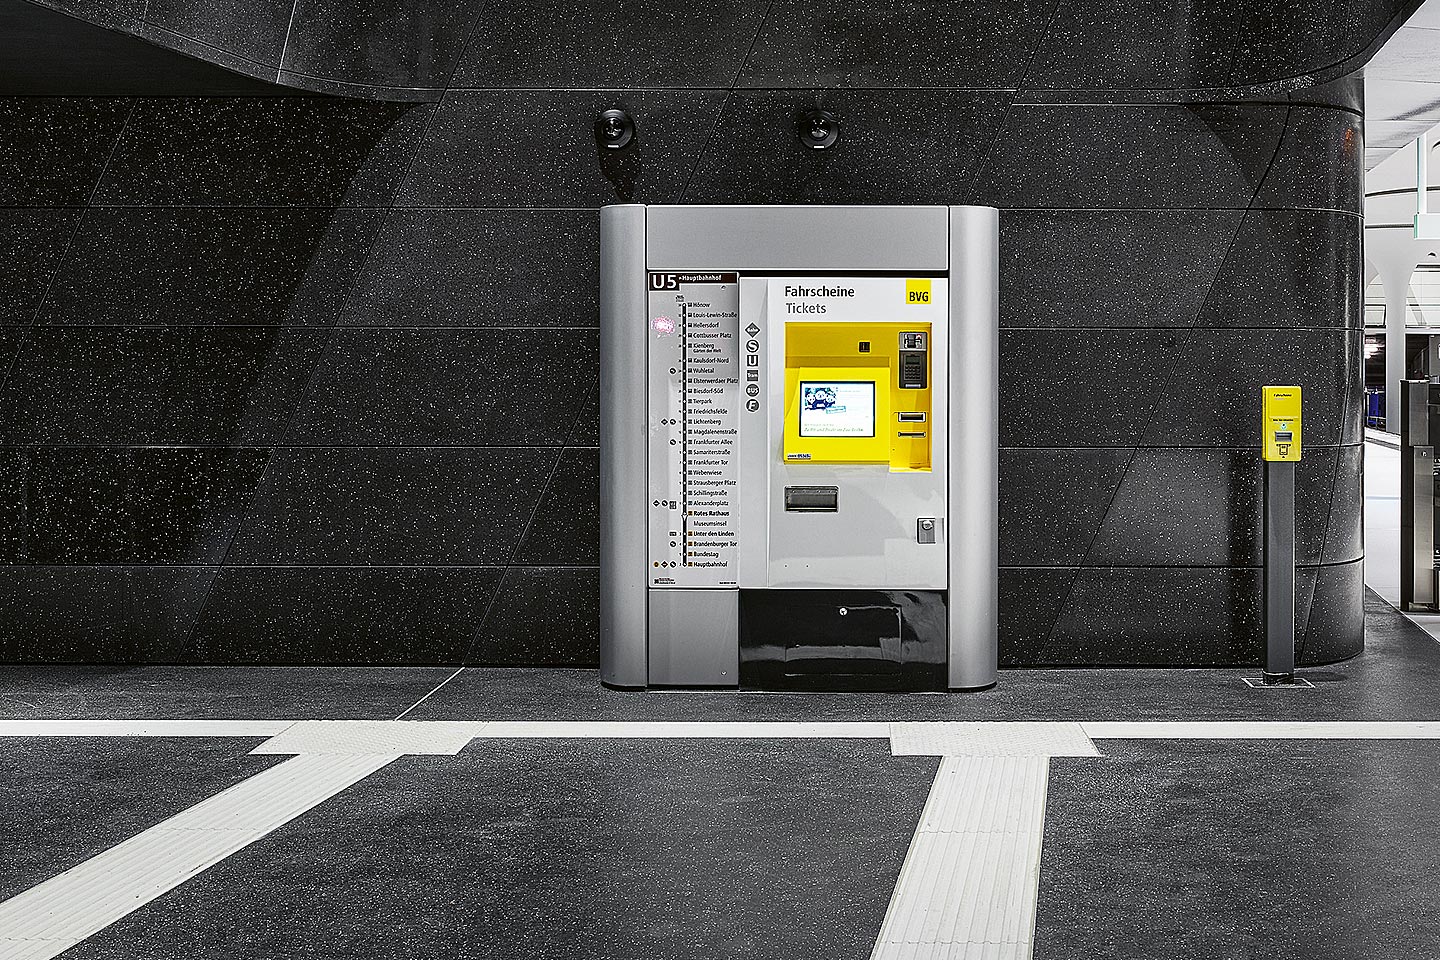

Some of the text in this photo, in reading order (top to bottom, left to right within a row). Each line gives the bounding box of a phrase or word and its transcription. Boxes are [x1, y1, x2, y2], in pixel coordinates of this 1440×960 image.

[682, 274, 722, 282] Hauptbahnhof
[784, 285, 855, 298] Fahrscheine
[909, 291, 929, 303] BVG
[785, 302, 827, 314] Tickets
